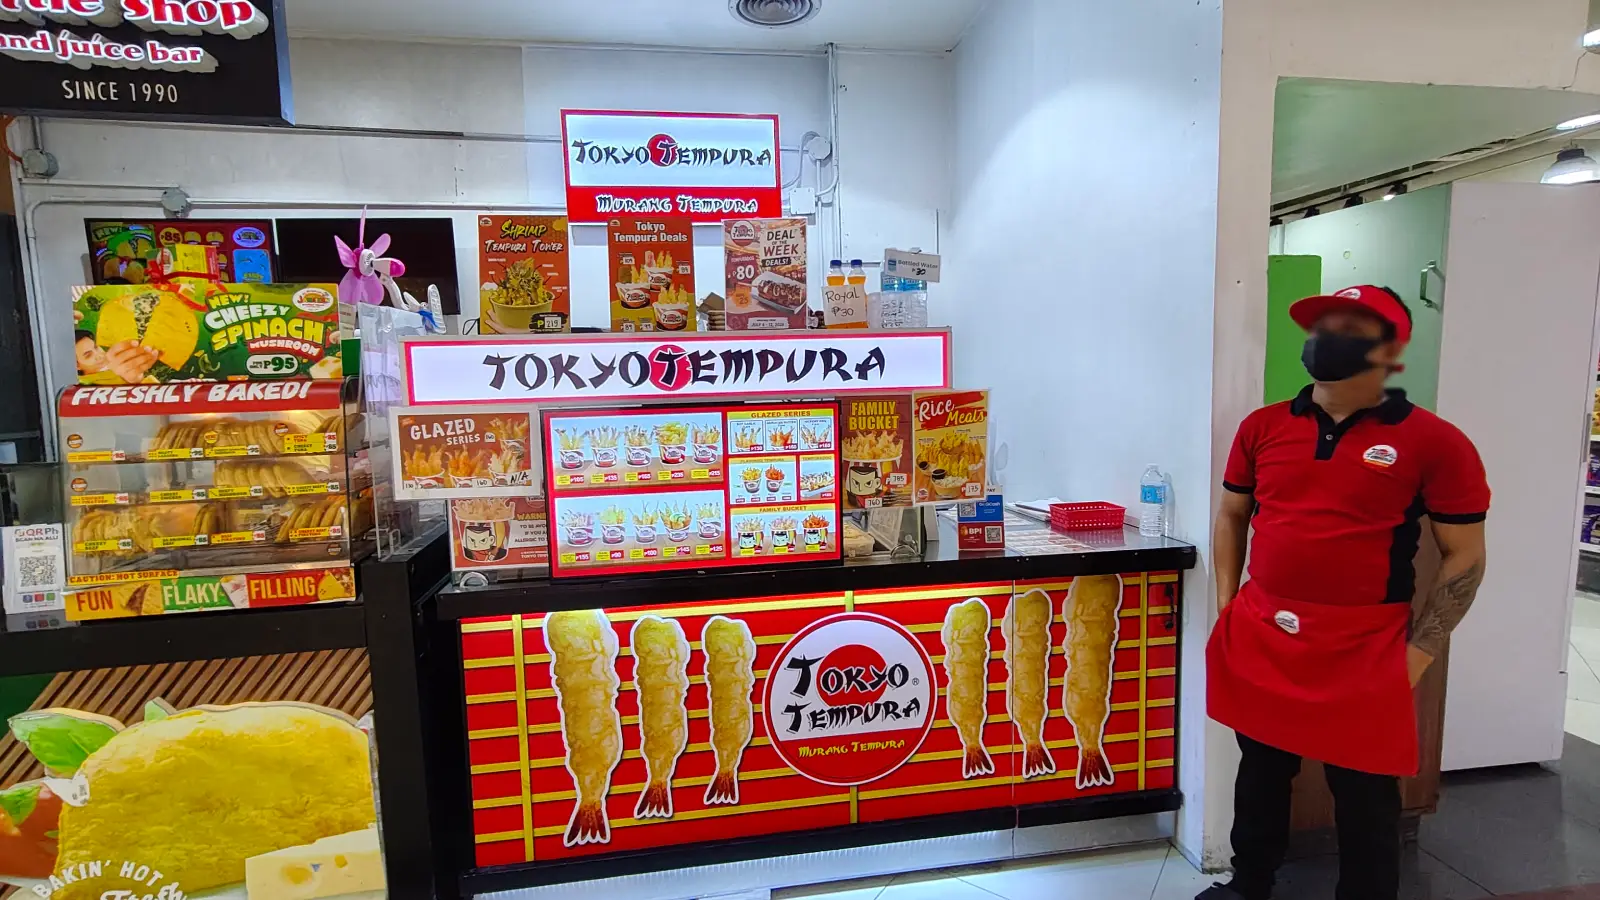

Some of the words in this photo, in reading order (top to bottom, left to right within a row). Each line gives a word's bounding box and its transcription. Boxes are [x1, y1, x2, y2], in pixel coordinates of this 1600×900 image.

[57, 29, 143, 61] juice
[147, 41, 203, 63] bar
[62, 80, 118, 101] SINCE
[129, 83, 178, 103] 1990
[572, 138, 649, 165] TOKYO
[657, 139, 772, 166] TEMPURA
[596, 194, 672, 213] MURANG
[676, 195, 758, 213] TEMPURA
[501, 219, 547, 238] SHRIMP
[635, 222, 665, 233] Tokyo
[767, 229, 795, 241] DEAL
[485, 240, 527, 252] TEMPURA
[532, 240, 563, 252] TOWER
[614, 233, 657, 244] Tempura
[660, 233, 688, 242] Deals
[764, 244, 798, 257] WEEK
[208, 294, 249, 309] NEW!
[205, 304, 290, 329] CHEEZY
[211, 317, 324, 351] SPINACH
[249, 340, 320, 356] MUSHROOM
[482, 350, 651, 390] TOKYO
[654, 346, 886, 388] TEMPURA
[72, 384, 201, 405] FRESHLY
[207, 381, 311, 402] BAKED!
[851, 401, 896, 416] FAMILY
[919, 400, 955, 422] Rice
[945, 410, 985, 426] Meals
[410, 418, 475, 440] GLAZED
[849, 416, 899, 431] BUCKET
[446, 434, 480, 446] SERIES
[510, 472, 528, 484] N/A
[45, 527, 59, 535] Ph
[70, 575, 115, 583] CAUTION:
[137, 571, 178, 579] SURFACE
[76, 590, 114, 613] FUN
[163, 582, 220, 606] FLAKY
[250, 577, 316, 600] FILLING
[784, 653, 909, 699] TOKYO
[781, 697, 921, 735] TEMPURA
[798, 744, 848, 758] MURANG
[851, 739, 905, 753] TEMPURA
[32, 859, 111, 898] BAKIN'
[119, 860, 164, 887] HOT
